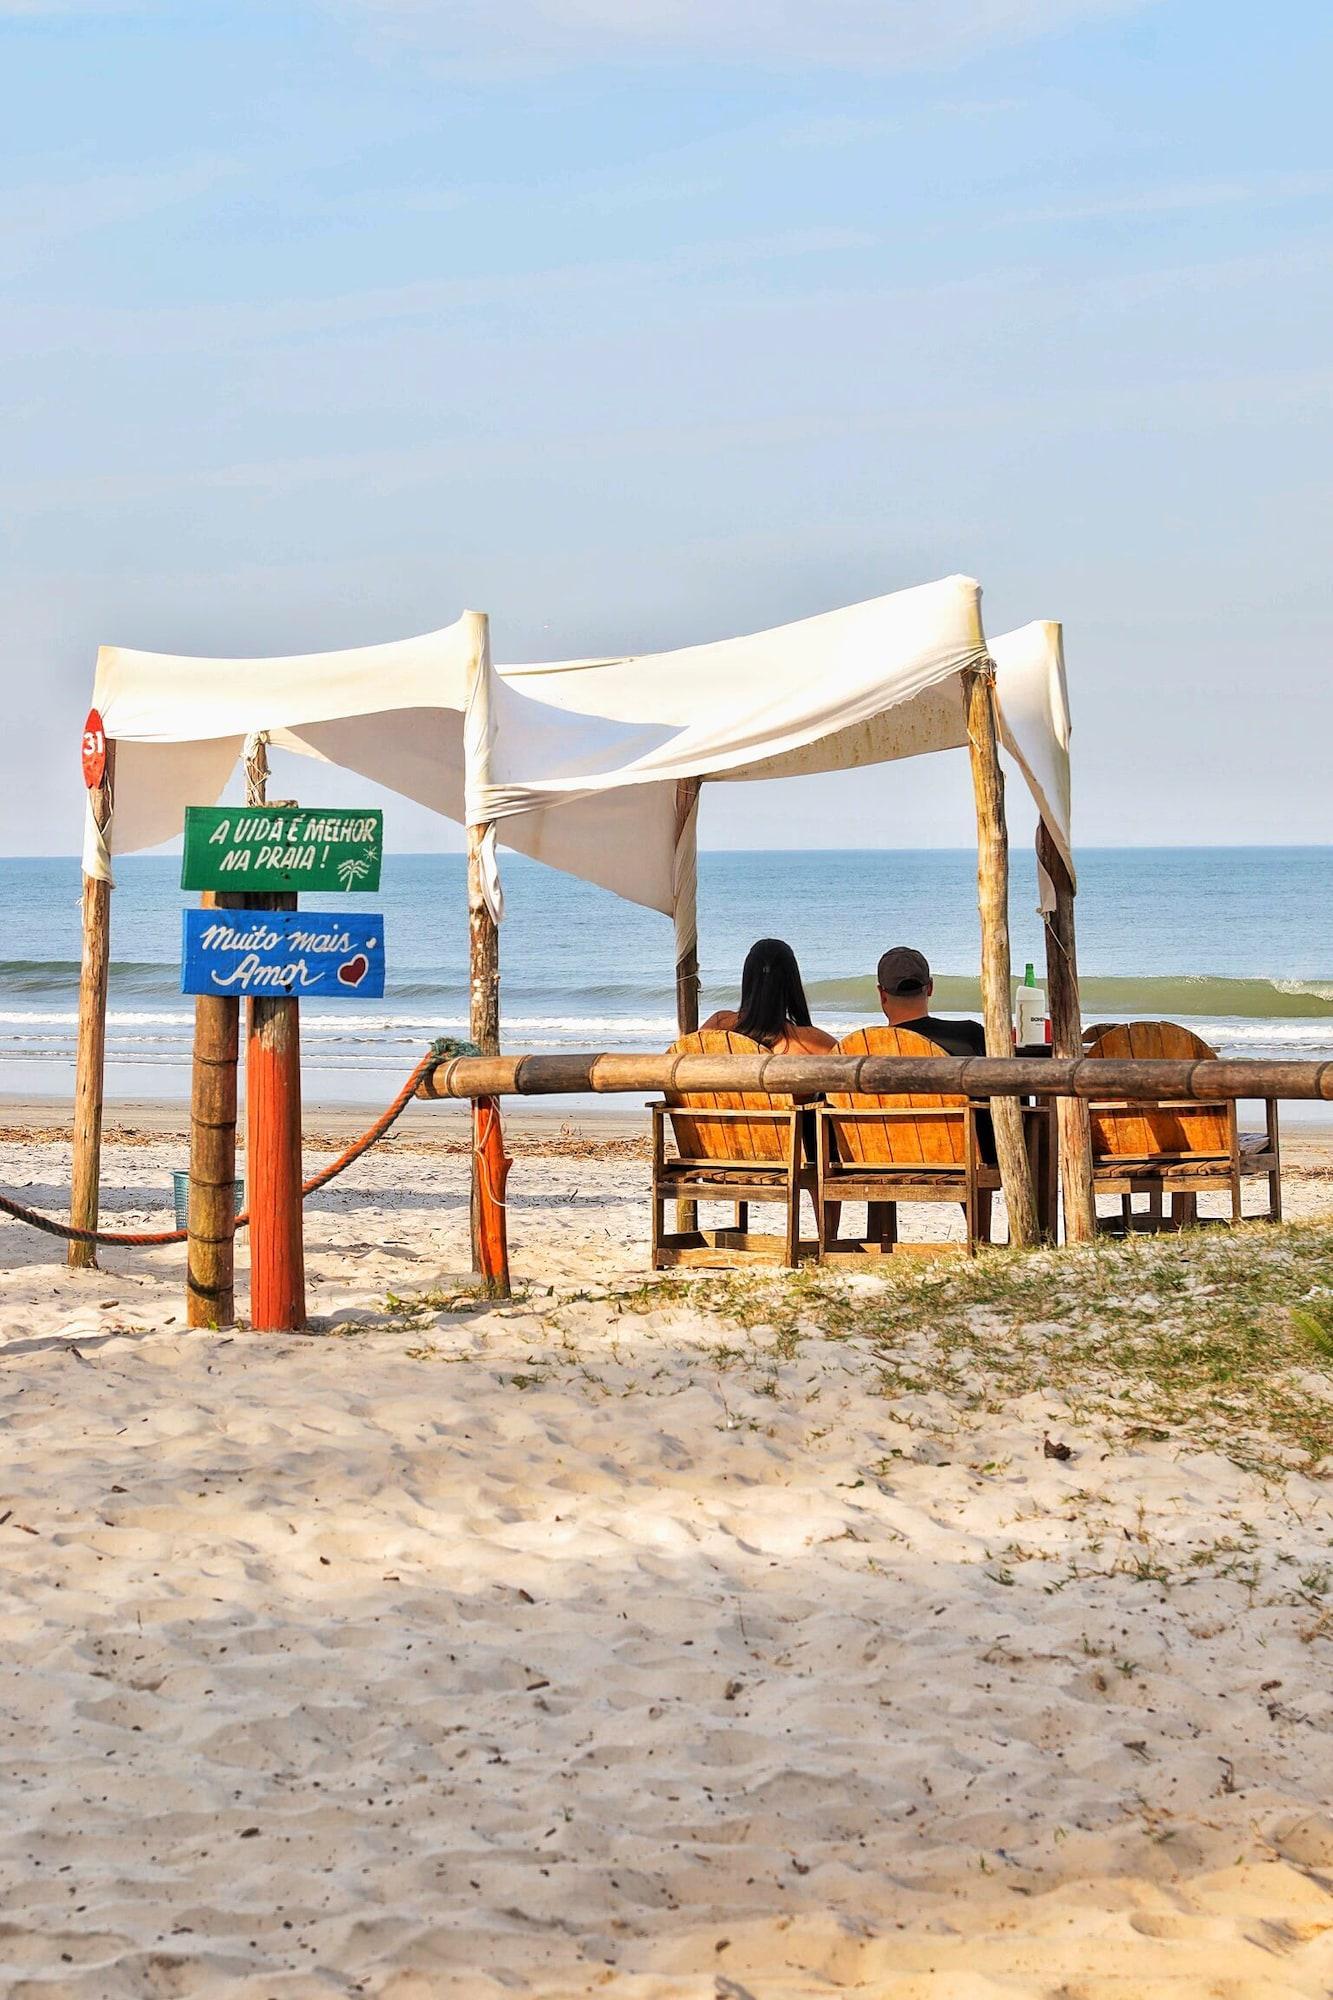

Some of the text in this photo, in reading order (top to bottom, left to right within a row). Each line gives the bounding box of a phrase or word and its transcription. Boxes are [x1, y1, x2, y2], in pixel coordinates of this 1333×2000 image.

[83, 730, 104, 756] 31
[209, 813, 378, 844] A VIDA É MELHOR
[219, 849, 251, 871] NA
[200, 923, 358, 953] Muito mais
[211, 953, 325, 989] Amor
